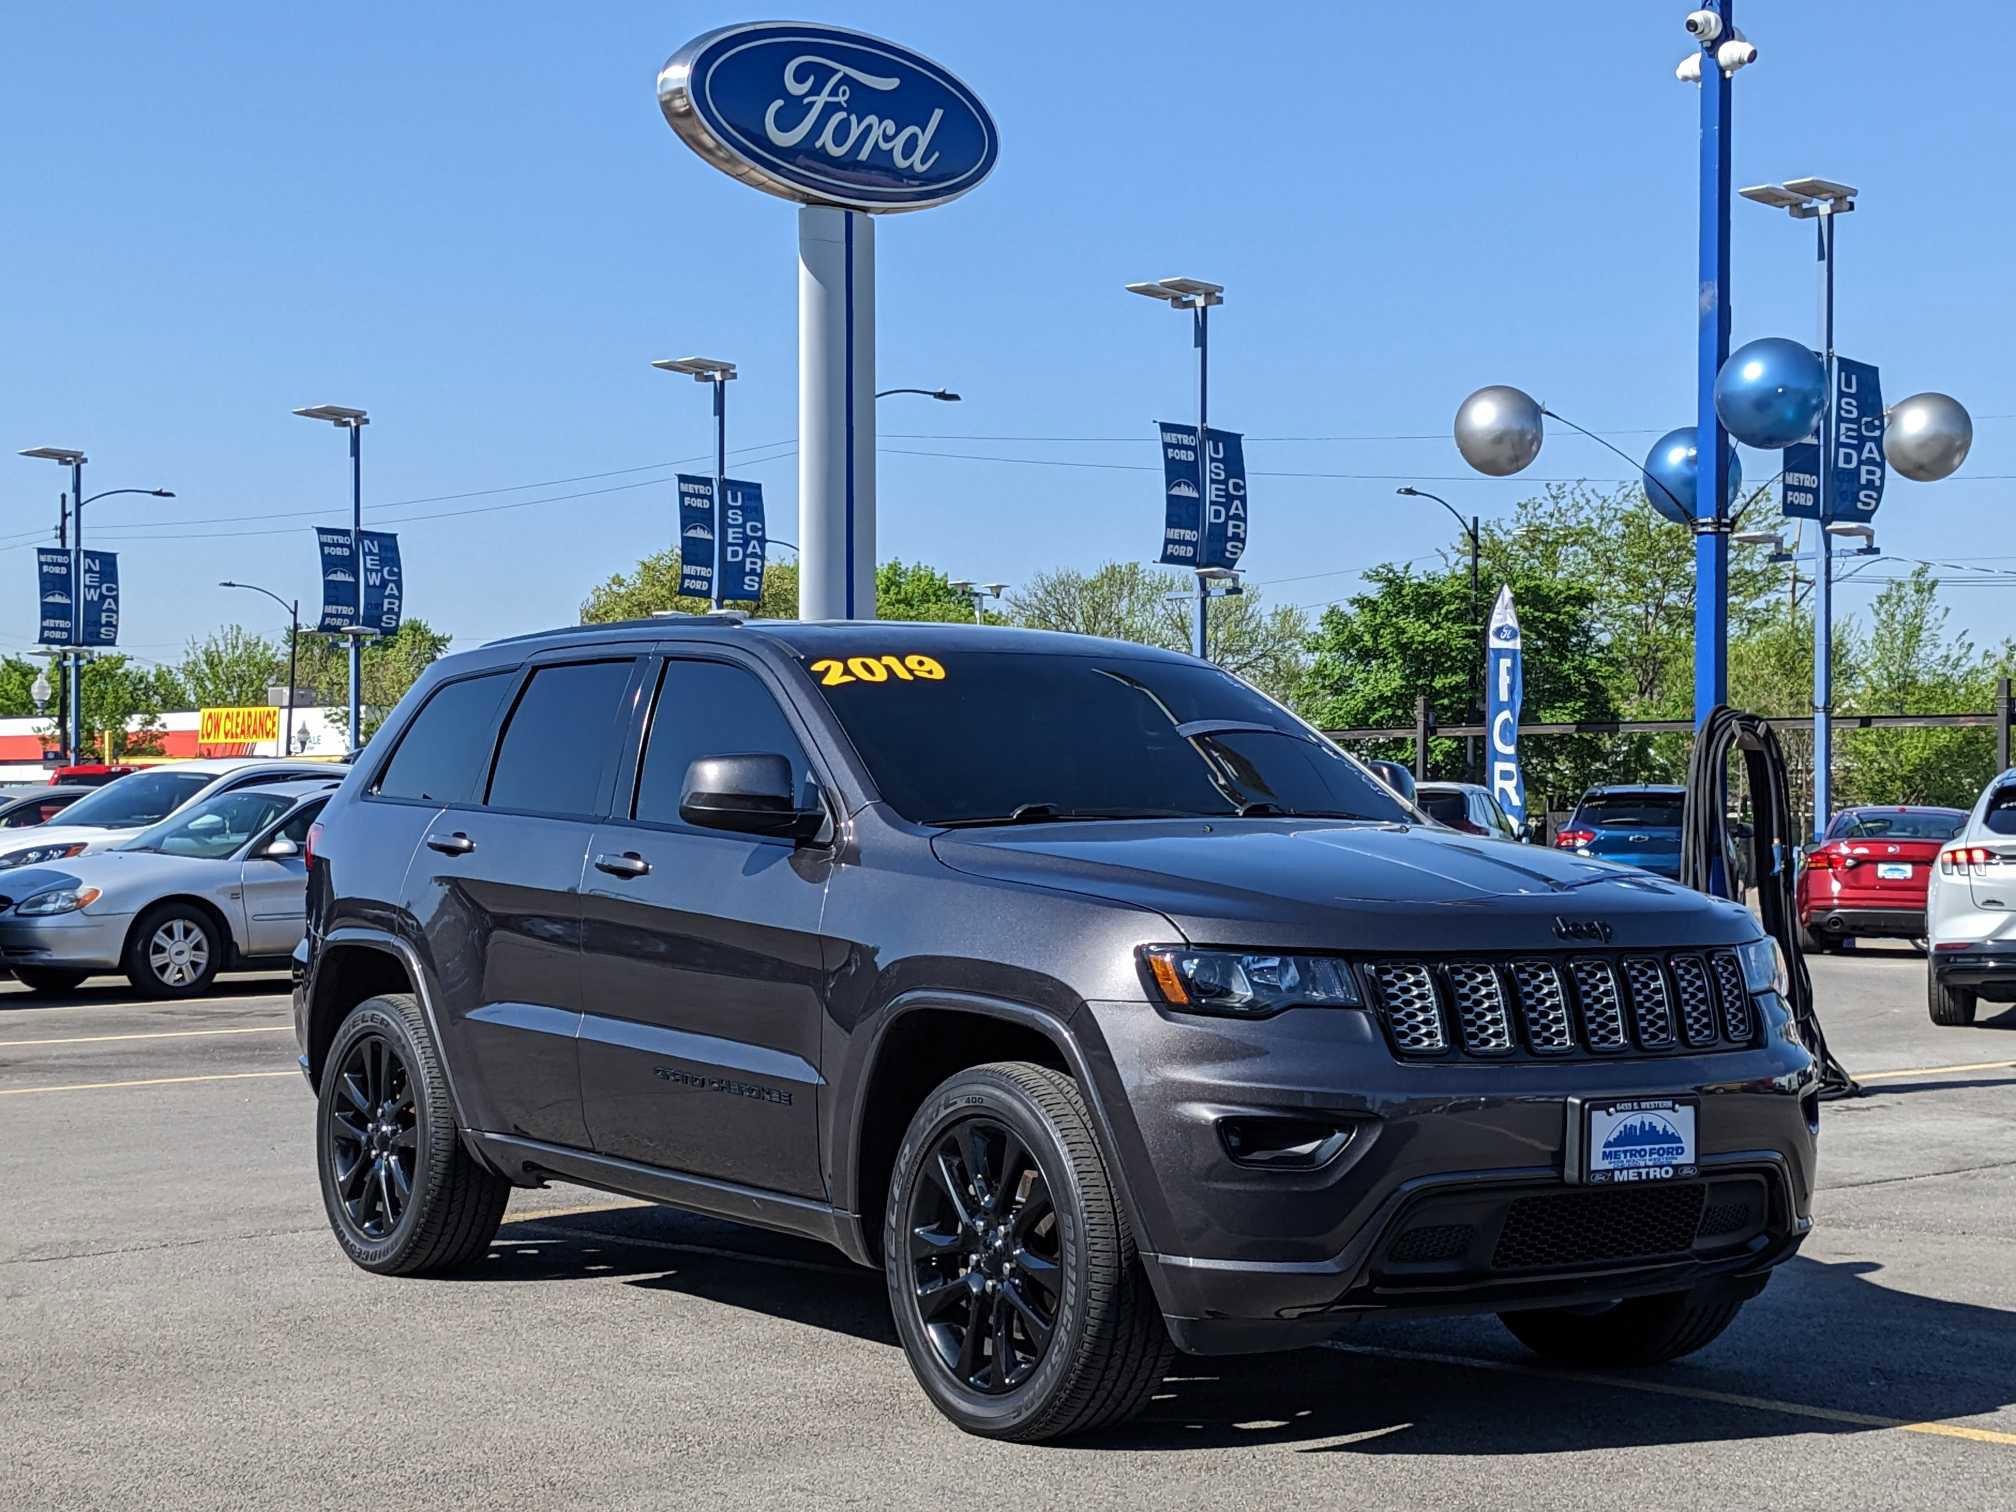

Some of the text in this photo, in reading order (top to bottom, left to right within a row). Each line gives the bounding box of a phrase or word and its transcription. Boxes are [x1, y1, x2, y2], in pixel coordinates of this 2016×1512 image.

[764, 55, 944, 173] Ford
[1838, 372, 1859, 470] USED
[1163, 432, 1196, 446] METRO
[1167, 449, 1194, 461] FORD
[1857, 417, 1882, 511] CARS
[1209, 440, 1226, 524] USED
[1785, 472, 1818, 488] METRO
[680, 483, 712, 495] METRO
[684, 496, 710, 508] FORD
[1787, 491, 1814, 506] FORD
[727, 490, 743, 562] USED
[1225, 478, 1246, 559] CARS
[319, 534, 351, 544] METRO
[1166, 527, 1198, 541] METRO
[324, 546, 350, 556] FORD
[743, 521, 763, 591] CARS
[1167, 544, 1193, 557] FORD
[40, 554, 69, 564] METRO
[364, 539, 381, 586] NEW
[43, 565, 67, 575] FORD
[683, 564, 713, 577] METRO
[84, 558, 100, 601] NEW
[684, 579, 709, 591] FORD
[381, 566, 399, 628] CARS
[100, 583, 117, 639] CARS
[324, 605, 354, 615] METRO
[42, 619, 71, 628] METRO
[325, 617, 350, 626] FORD
[44, 630, 68, 639] FORD
[810, 654, 946, 686] 2019
[201, 710, 277, 739] LOW CLEARANCE
[1551, 914, 1612, 944] Jeep
[338, 1013, 391, 1042] UELER
[965, 1096, 984, 1104] 400
[1614, 1166, 1673, 1182] METRO
